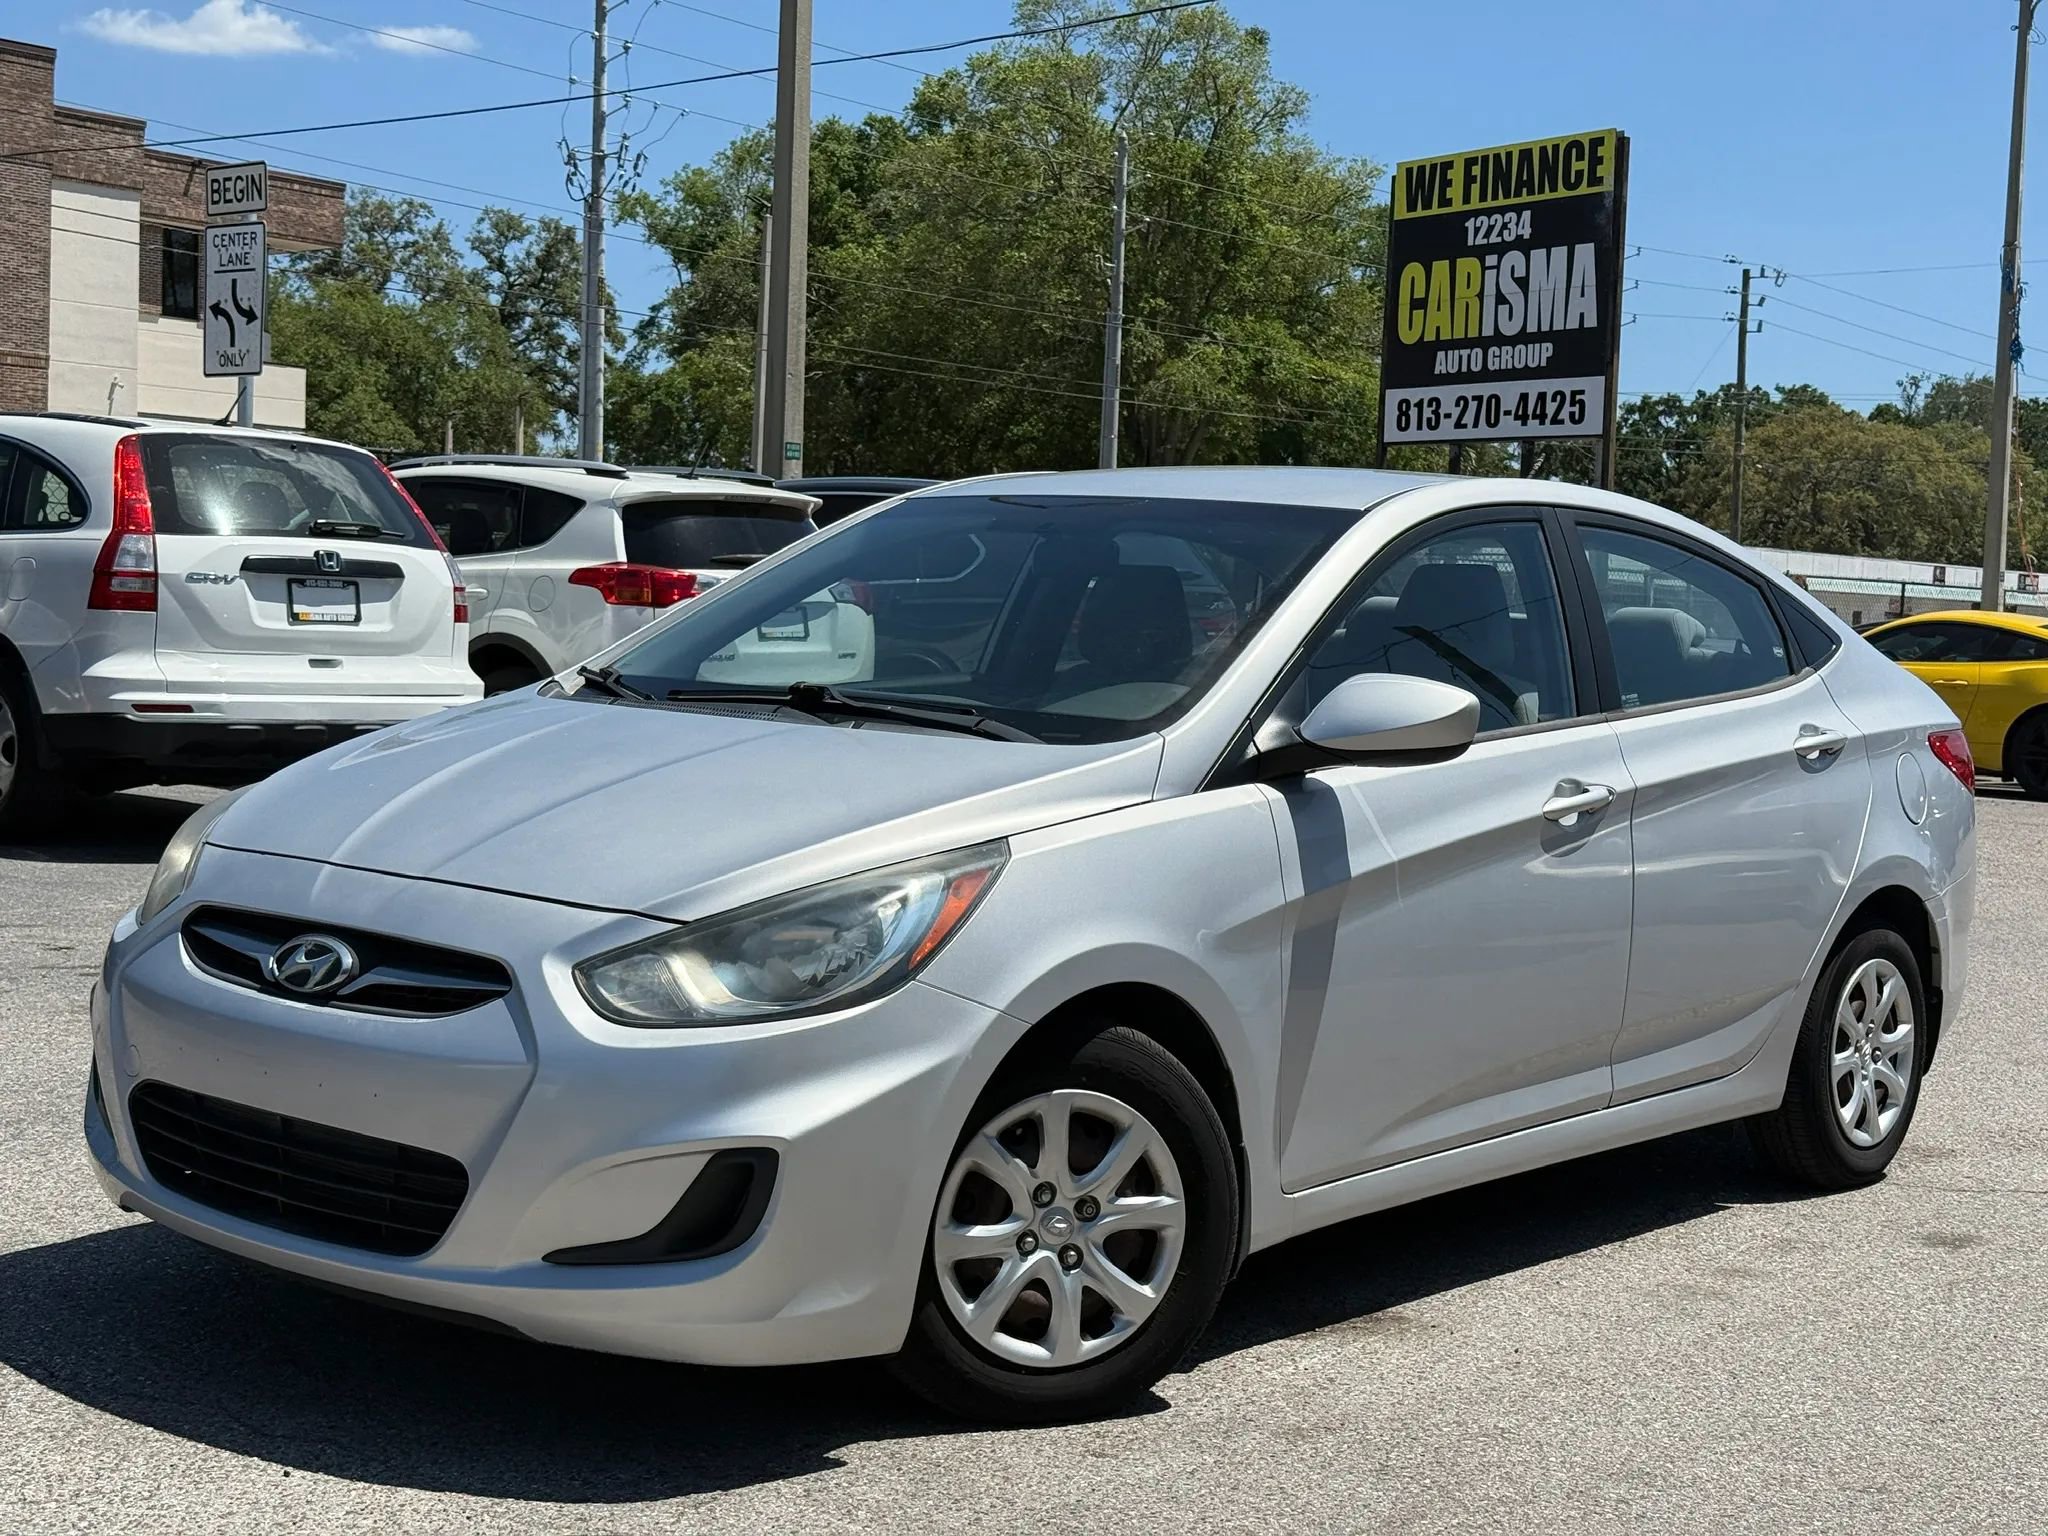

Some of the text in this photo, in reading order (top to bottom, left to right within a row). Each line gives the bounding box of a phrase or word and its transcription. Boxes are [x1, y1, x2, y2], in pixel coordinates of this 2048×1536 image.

[210, 173, 262, 206] BEGIN
[1405, 136, 1605, 213] WE FINANCE
[212, 231, 258, 248] CENTER
[1464, 209, 1532, 246] 12234
[219, 252, 251, 267] LANE
[218, 352, 247, 368] ONLY
[1434, 342, 1554, 375] AUTO GROUP
[1396, 389, 1586, 433] 813-270-4425
[185, 571, 240, 585] CR-V
